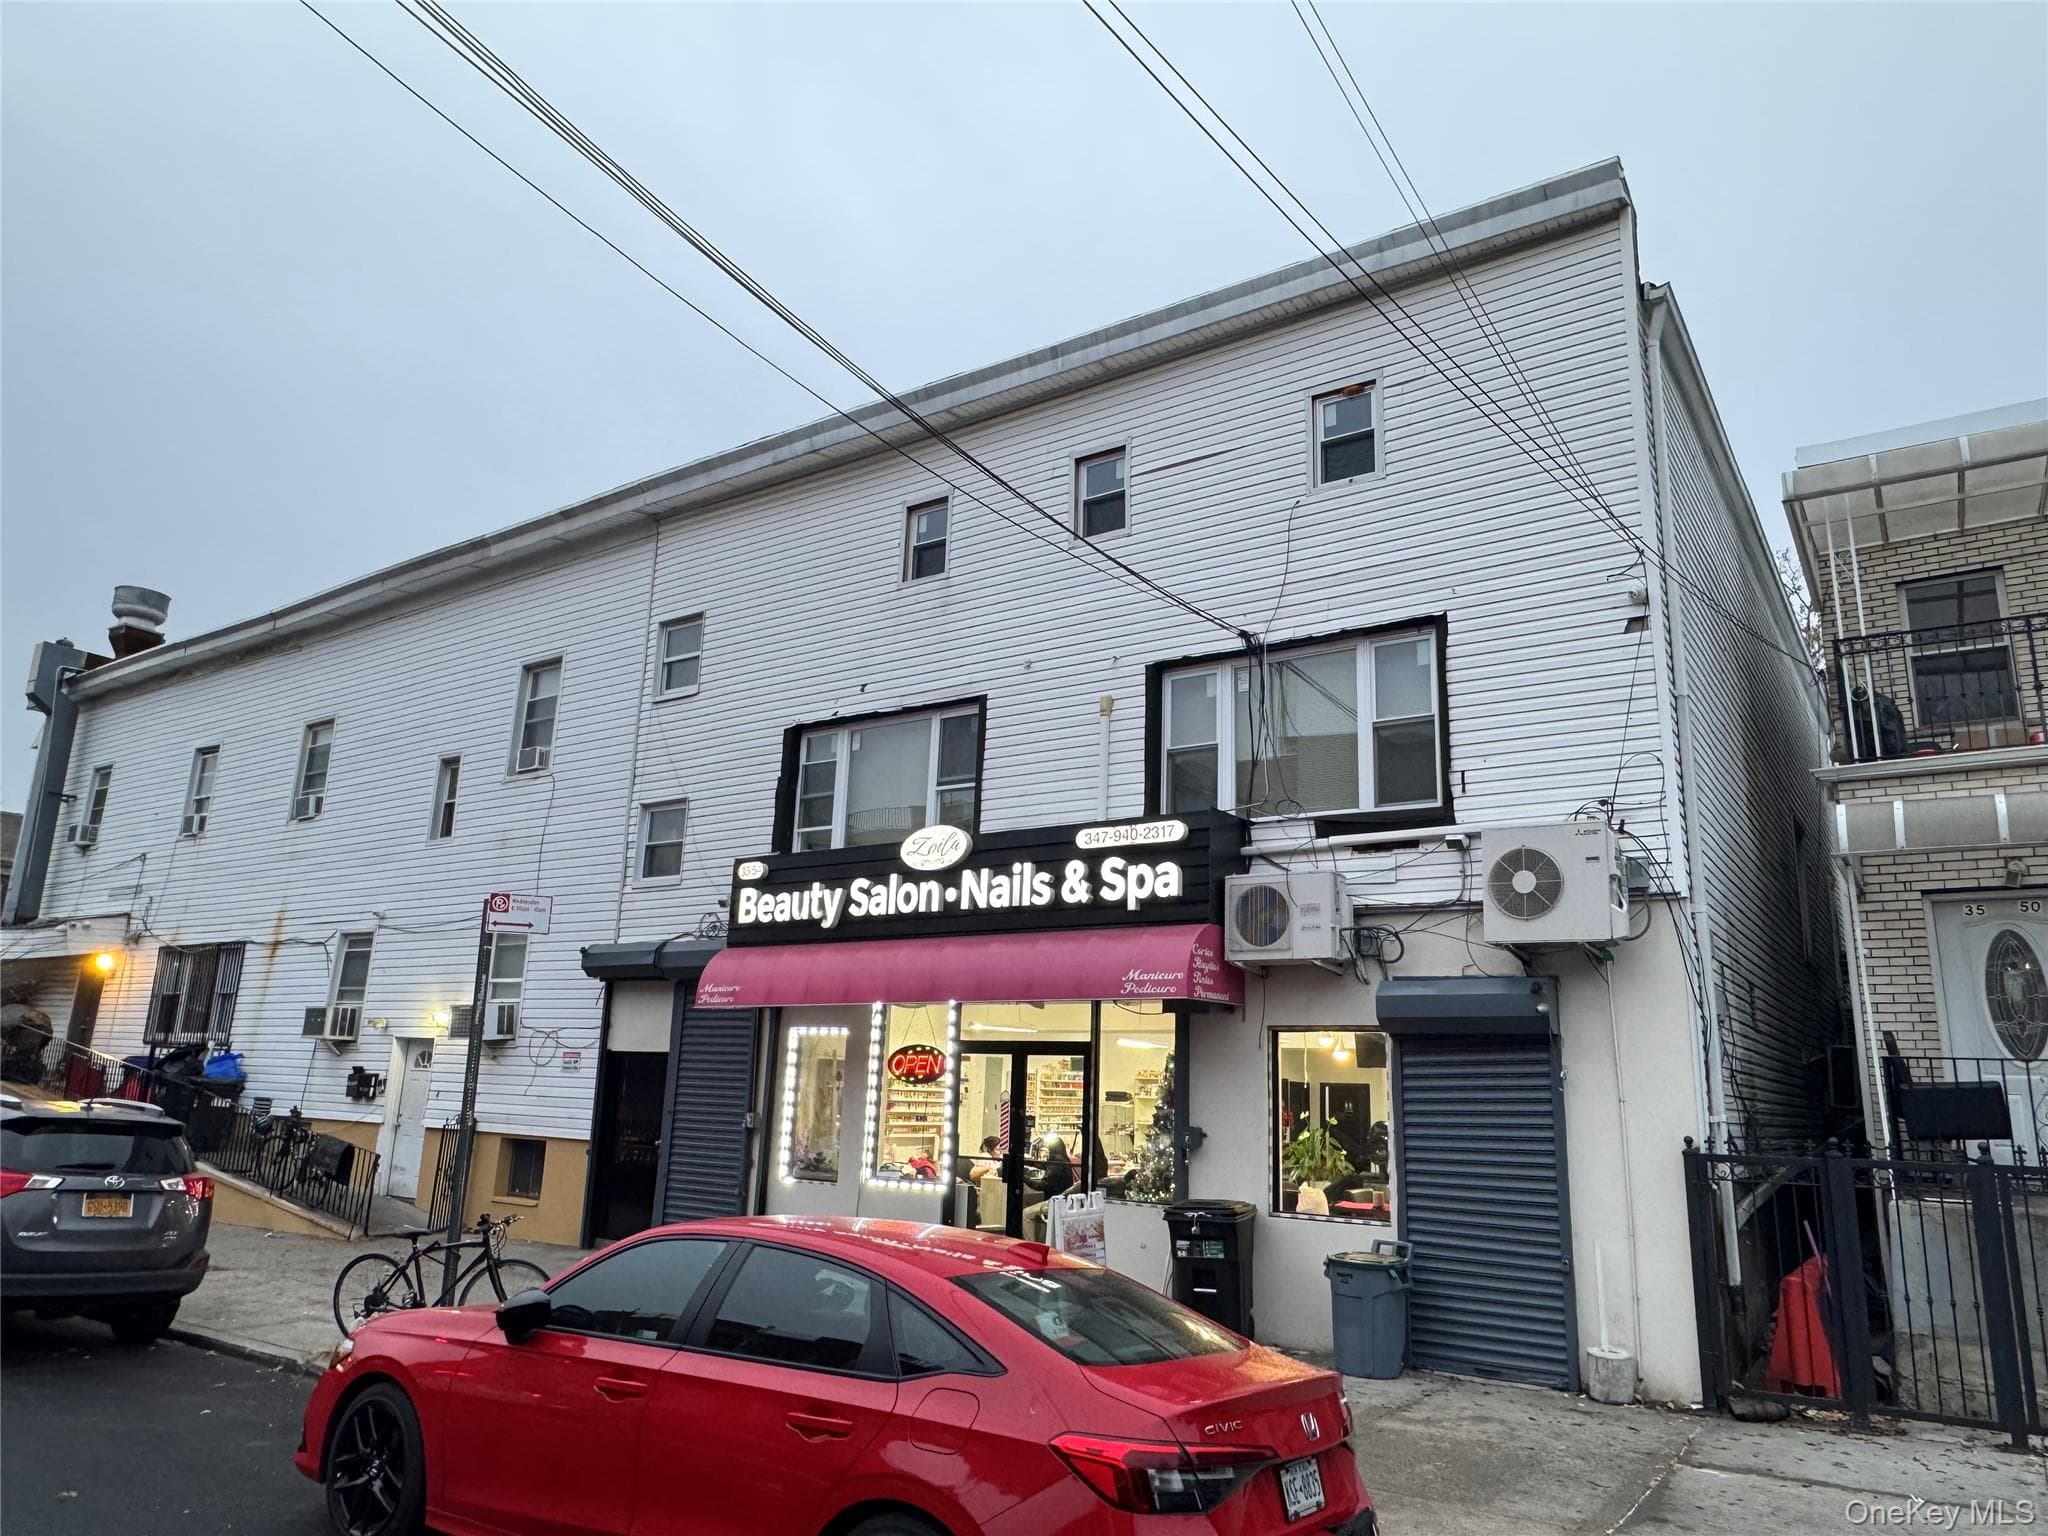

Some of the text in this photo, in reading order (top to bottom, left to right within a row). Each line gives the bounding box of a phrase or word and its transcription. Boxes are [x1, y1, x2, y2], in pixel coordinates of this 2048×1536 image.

[1084, 825, 1175, 845] 347-940-2317
[737, 882, 845, 929] Beauty
[1061, 859, 1092, 904] &
[1099, 856, 1181, 911] Spa
[1964, 901, 2041, 916] 35 50
[892, 1054, 943, 1074] OPEN
[1204, 1420, 1243, 1435] CIVIC
